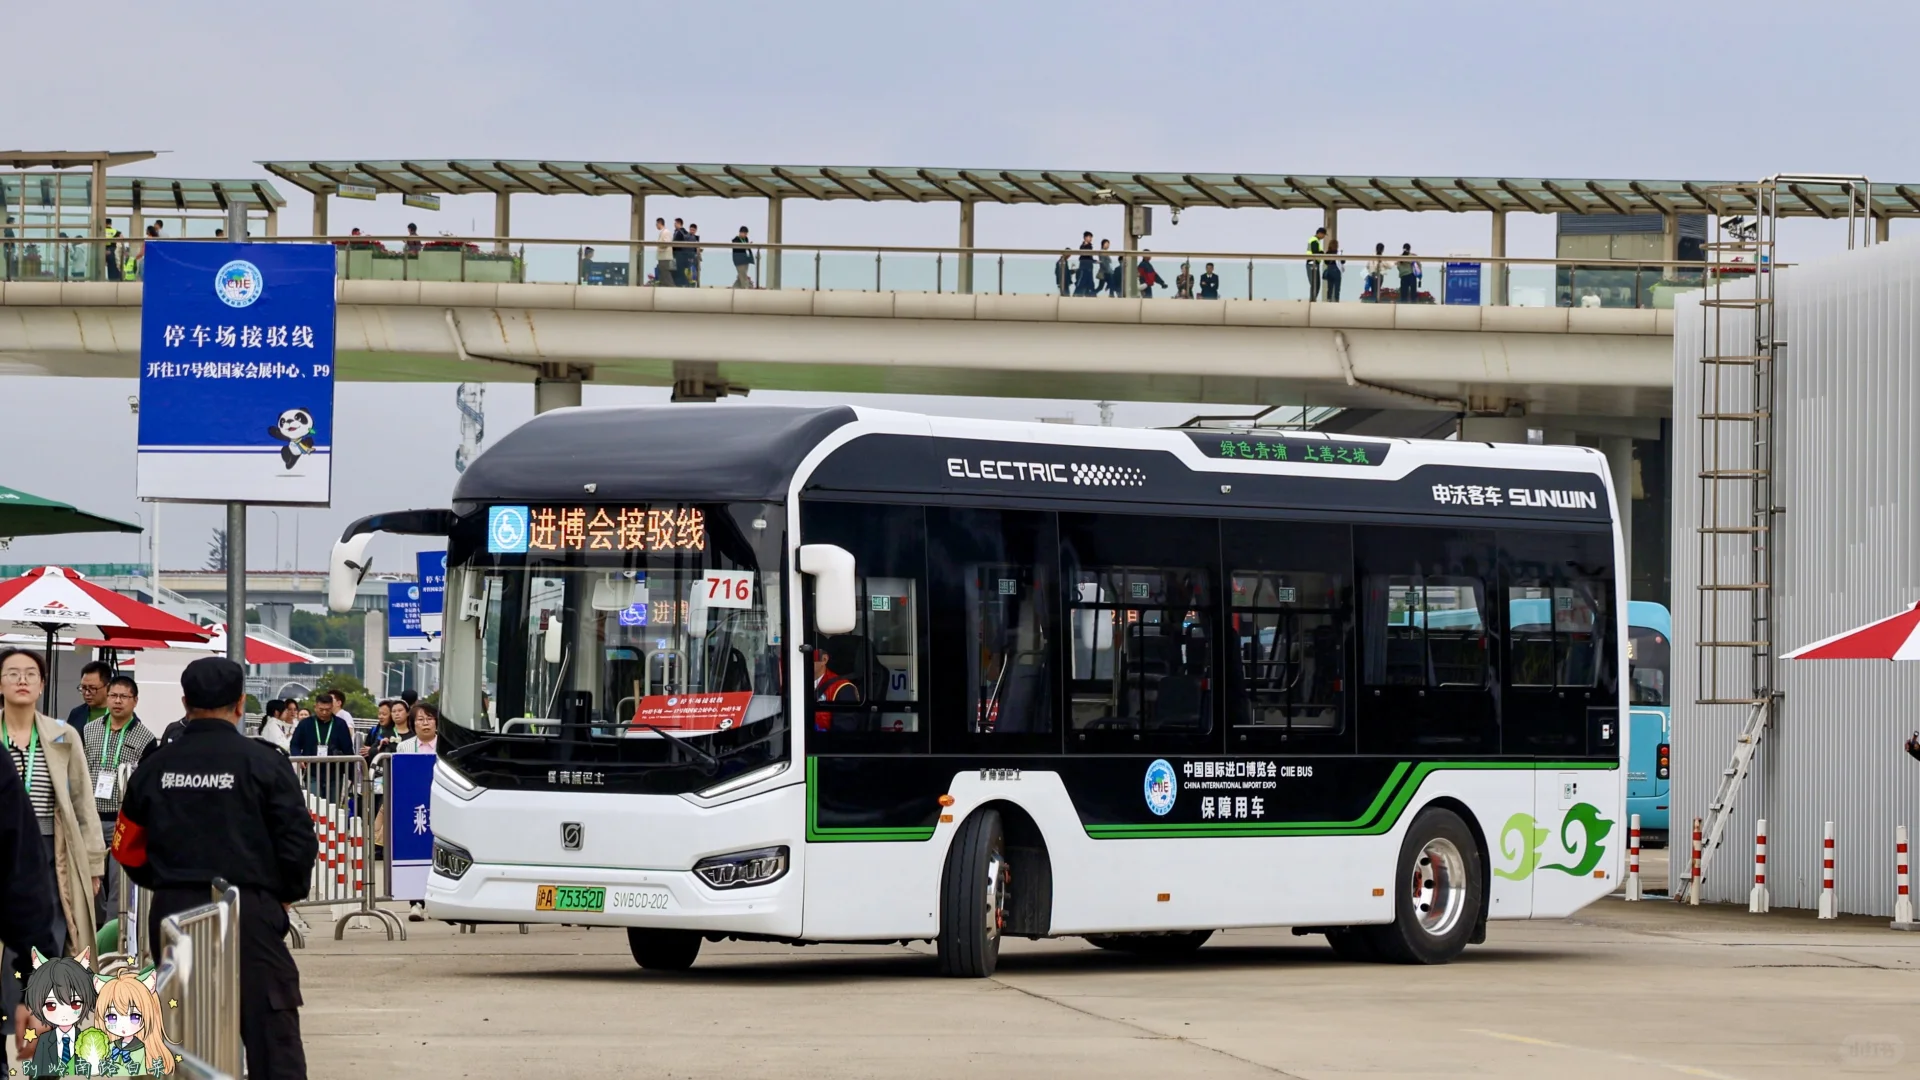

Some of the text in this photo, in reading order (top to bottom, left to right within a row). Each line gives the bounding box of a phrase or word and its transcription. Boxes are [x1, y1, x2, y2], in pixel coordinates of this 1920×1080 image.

[163, 325, 314, 348] 停车场接驳线
[147, 362, 330, 379] 开往17号线国家会展中心、P9
[1220, 440, 1369, 464] 绿色青浦 上善之城
[947, 458, 1068, 482] ELECTRIC
[1432, 484, 1597, 509] 申沃客车 SUNWIN
[528, 507, 704, 550] 进博会接驳线
[706, 577, 749, 600] 716
[161, 772, 235, 789] 保BAOAN安
[1183, 761, 1277, 778] 中国国际进口博览会
[1281, 766, 1295, 777] CIIE
[1297, 766, 1313, 777] BUS
[1201, 781, 1241, 789] INTERNATIONAL
[1242, 781, 1262, 789] IMPORT
[1263, 781, 1277, 789] EXPO
[1201, 796, 1264, 819] 保障用车
[413, 804, 430, 835] 乘
[613, 892, 669, 909] SWBCD-202
